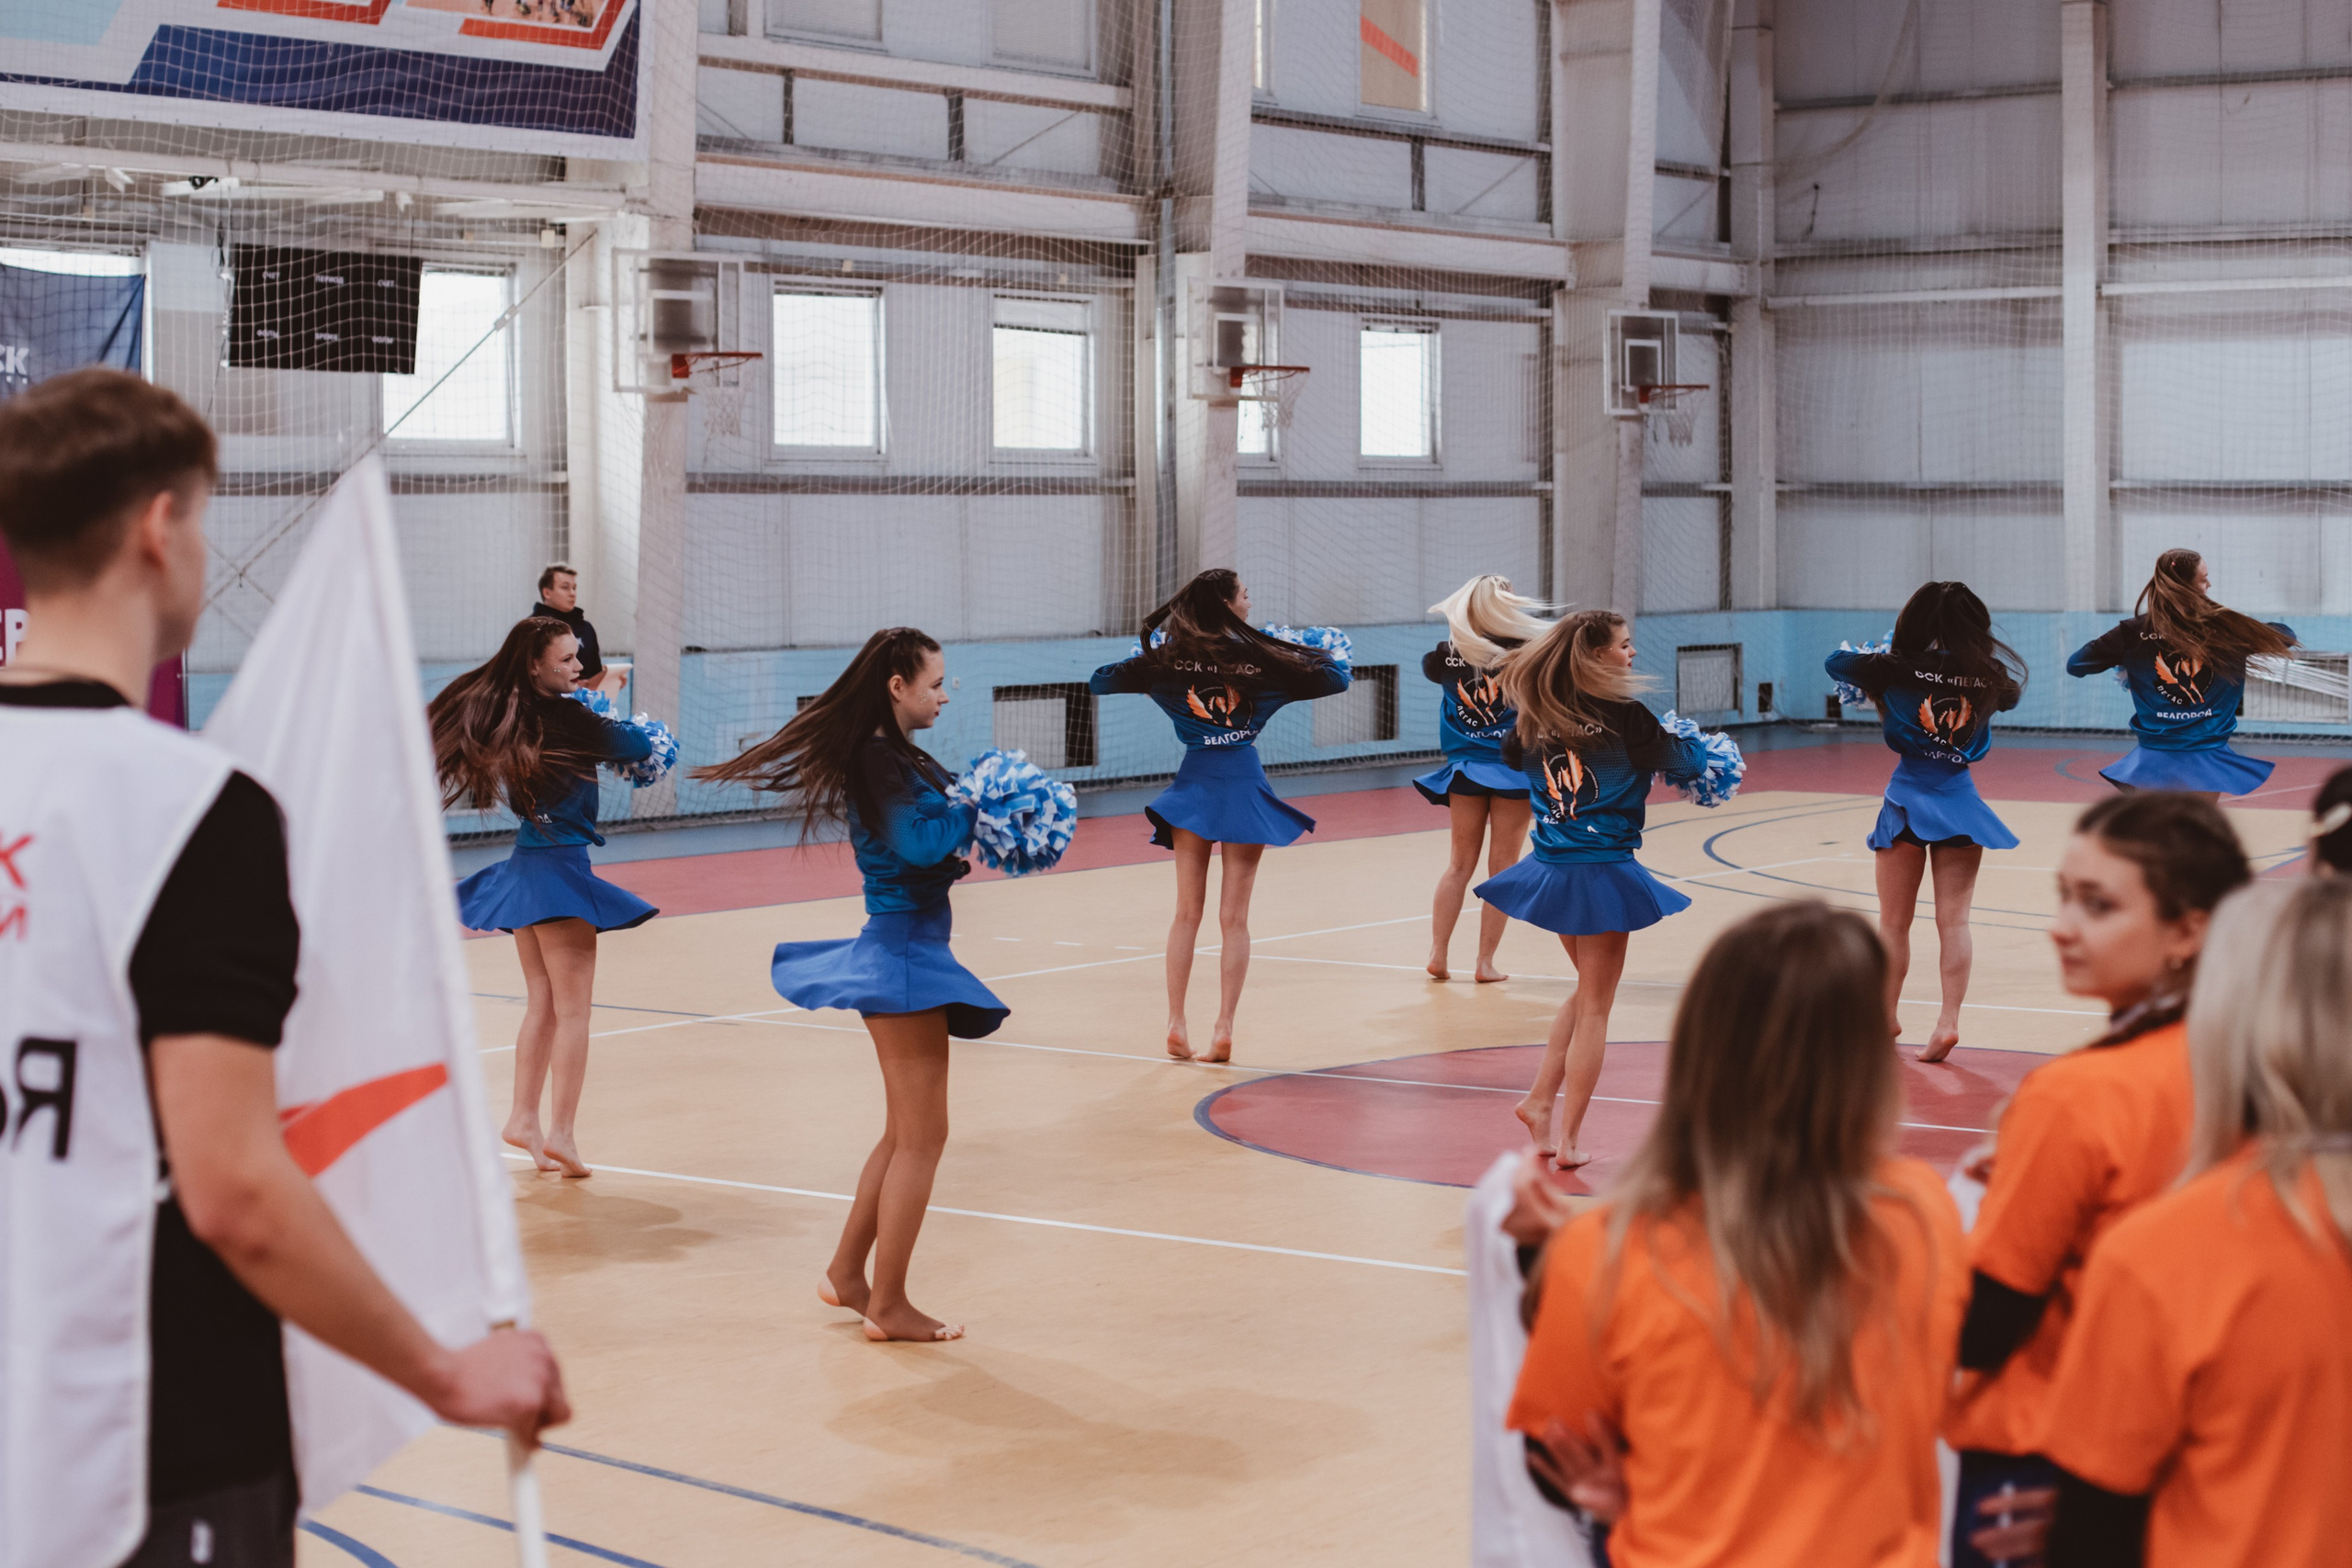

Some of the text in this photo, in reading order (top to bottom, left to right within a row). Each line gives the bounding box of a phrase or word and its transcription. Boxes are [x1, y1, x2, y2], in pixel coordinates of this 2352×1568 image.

[315, 275, 344, 285] ПЕРИОД
[378, 279, 395, 288] СЧЕТ
[0, 608, 31, 668] Р
[1174, 660, 1202, 672] ССК
[1445, 657, 1465, 667] ССК
[2157, 685, 2183, 705] ПЕГАС
[1457, 705, 1478, 727] ПЕГАС
[1204, 729, 1259, 746] БЕЛГОРО
[0, 1035, 77, 1161] Я
